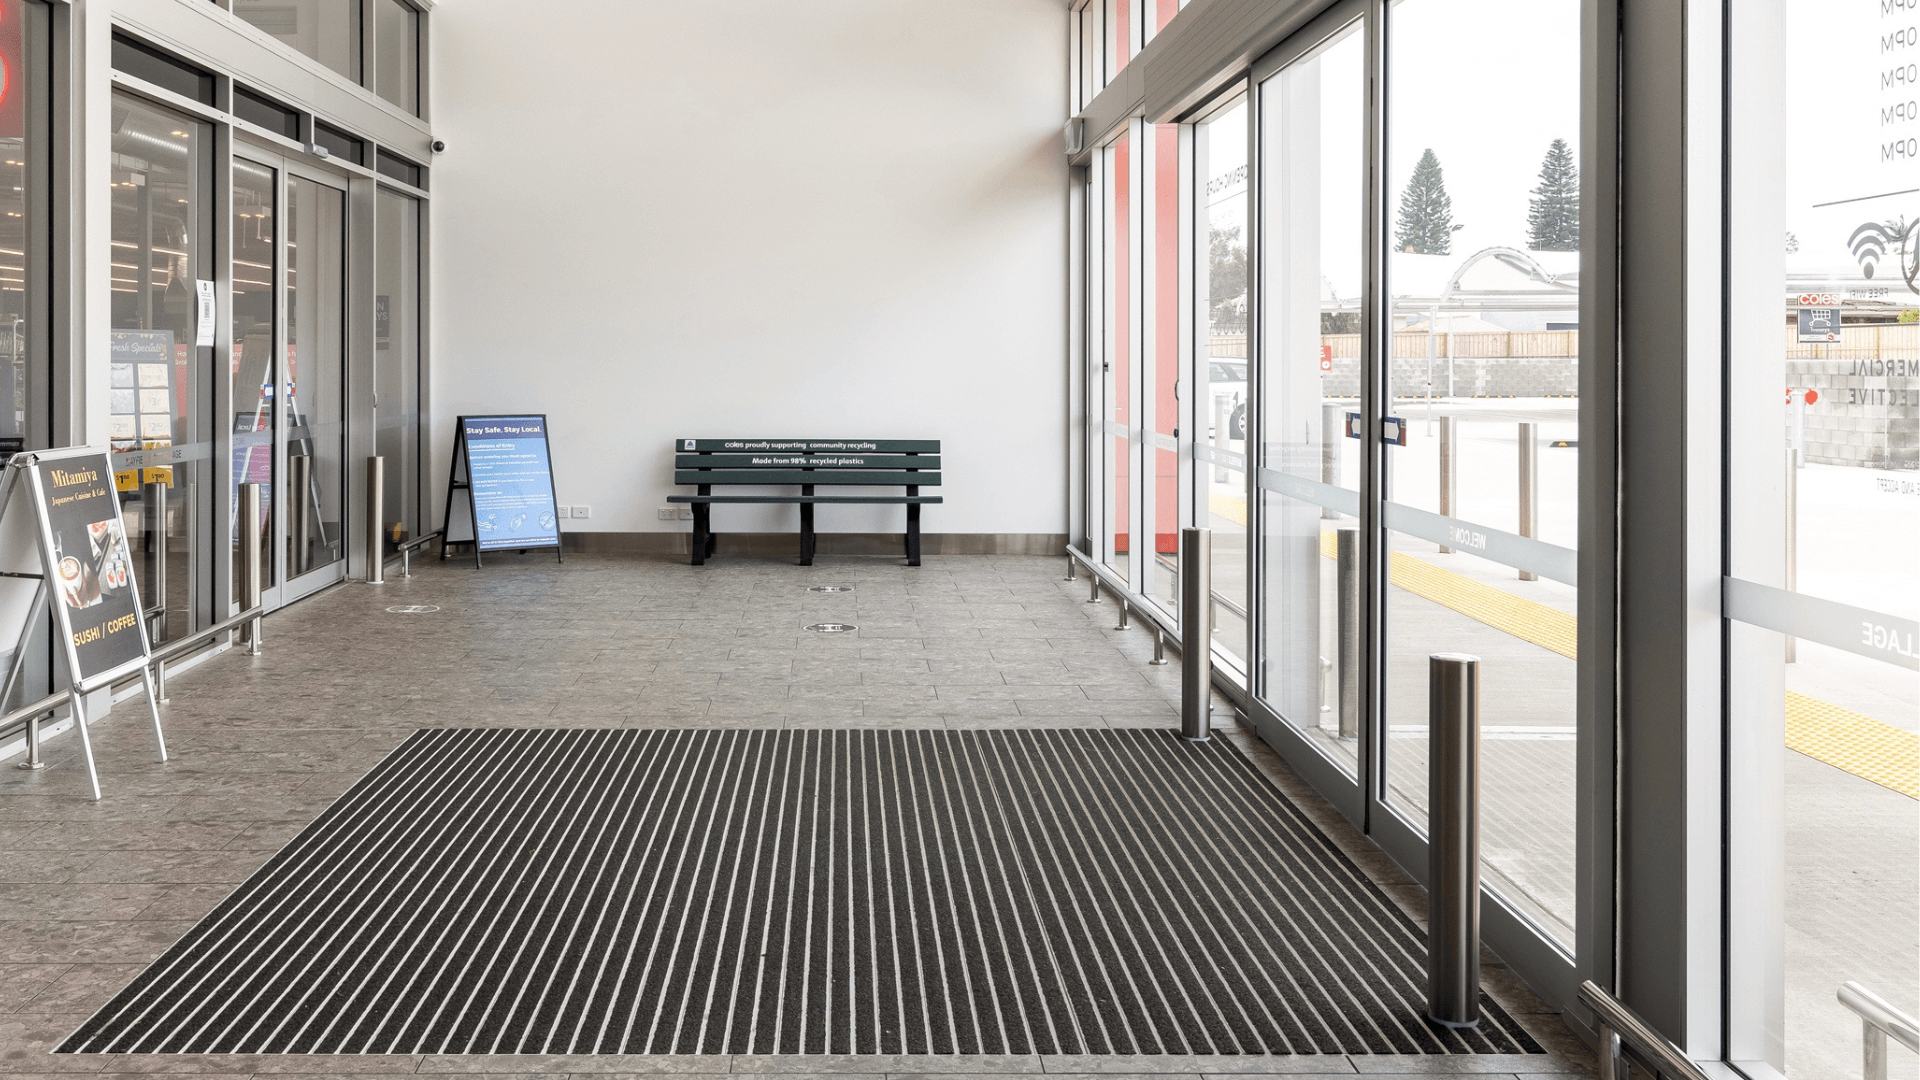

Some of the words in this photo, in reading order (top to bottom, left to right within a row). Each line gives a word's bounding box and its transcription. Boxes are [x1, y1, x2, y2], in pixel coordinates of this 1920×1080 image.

[1799, 294, 1839, 305] coles
[130, 342, 162, 355] Specials
[466, 427, 483, 435] Stay
[484, 426, 503, 434] Safe.
[503, 426, 520, 434] Stay
[745, 441, 770, 450] proudly
[771, 441, 807, 450] supporting
[809, 441, 846, 450] community
[847, 441, 876, 450] recycling
[752, 457, 771, 465] Made
[773, 457, 789, 465] from
[790, 457, 807, 465] 98%
[809, 457, 838, 465] recycled
[838, 457, 864, 466] plastics
[51, 466, 97, 489] Mitamiya
[51, 495, 75, 507] Japanese
[75, 491, 91, 502] Cuisine
[74, 626, 101, 647] SUSHI
[107, 612, 136, 634] COFFEE
